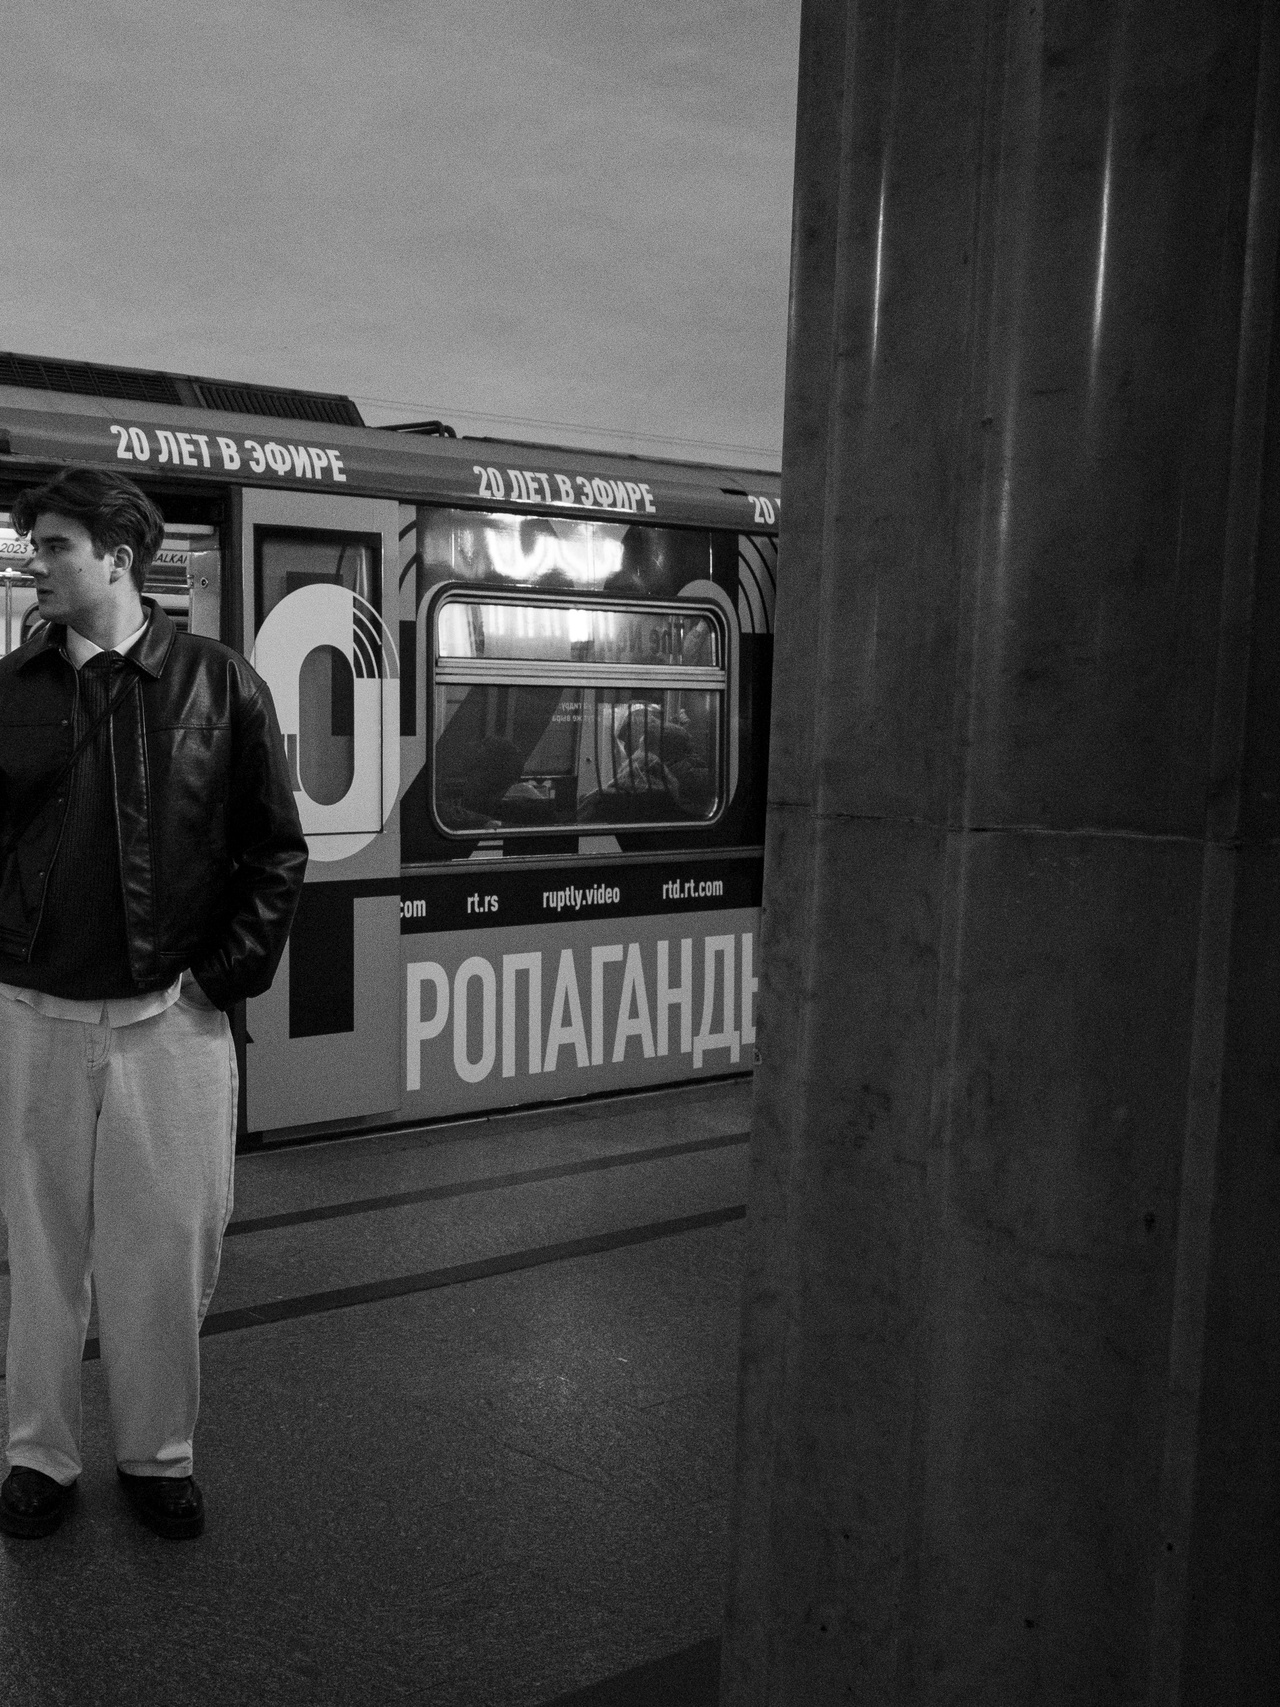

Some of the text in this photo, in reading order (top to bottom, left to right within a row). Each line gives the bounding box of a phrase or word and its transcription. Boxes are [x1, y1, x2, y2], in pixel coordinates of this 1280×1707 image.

[109, 424, 347, 482] 20 ЛЕТ В ЭФИРЕ
[472, 465, 656, 514] 20 ЛЕТ В ЭФИРЕ
[747, 494, 776, 525] 20
[467, 892, 499, 914] rt.rs
[542, 884, 621, 912] ruptly.video
[662, 878, 724, 900] rtd.rt.com
